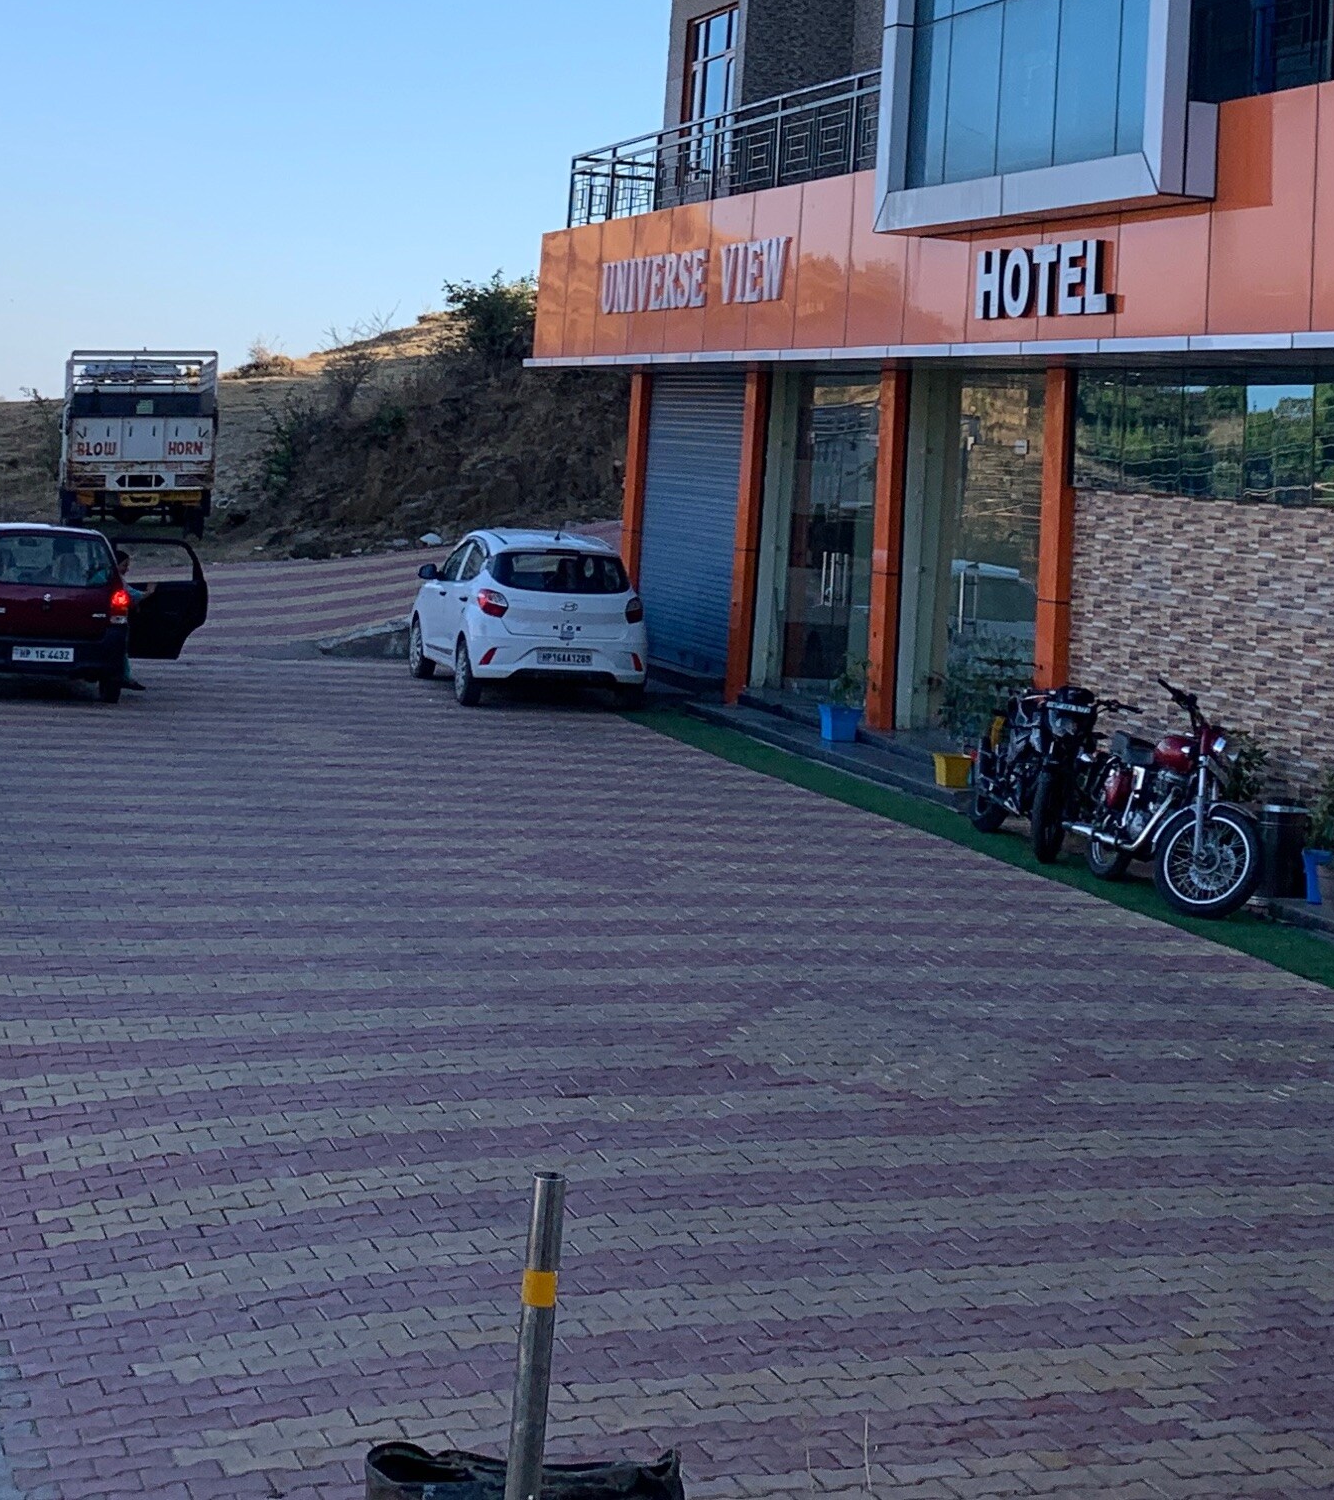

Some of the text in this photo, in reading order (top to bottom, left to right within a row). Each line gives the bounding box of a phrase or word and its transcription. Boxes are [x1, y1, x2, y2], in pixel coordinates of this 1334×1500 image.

[601, 236, 792, 315] UNIVERSE VIEW
[975, 239, 1113, 320] HOTEL
[77, 442, 203, 456] BLOW HORN
